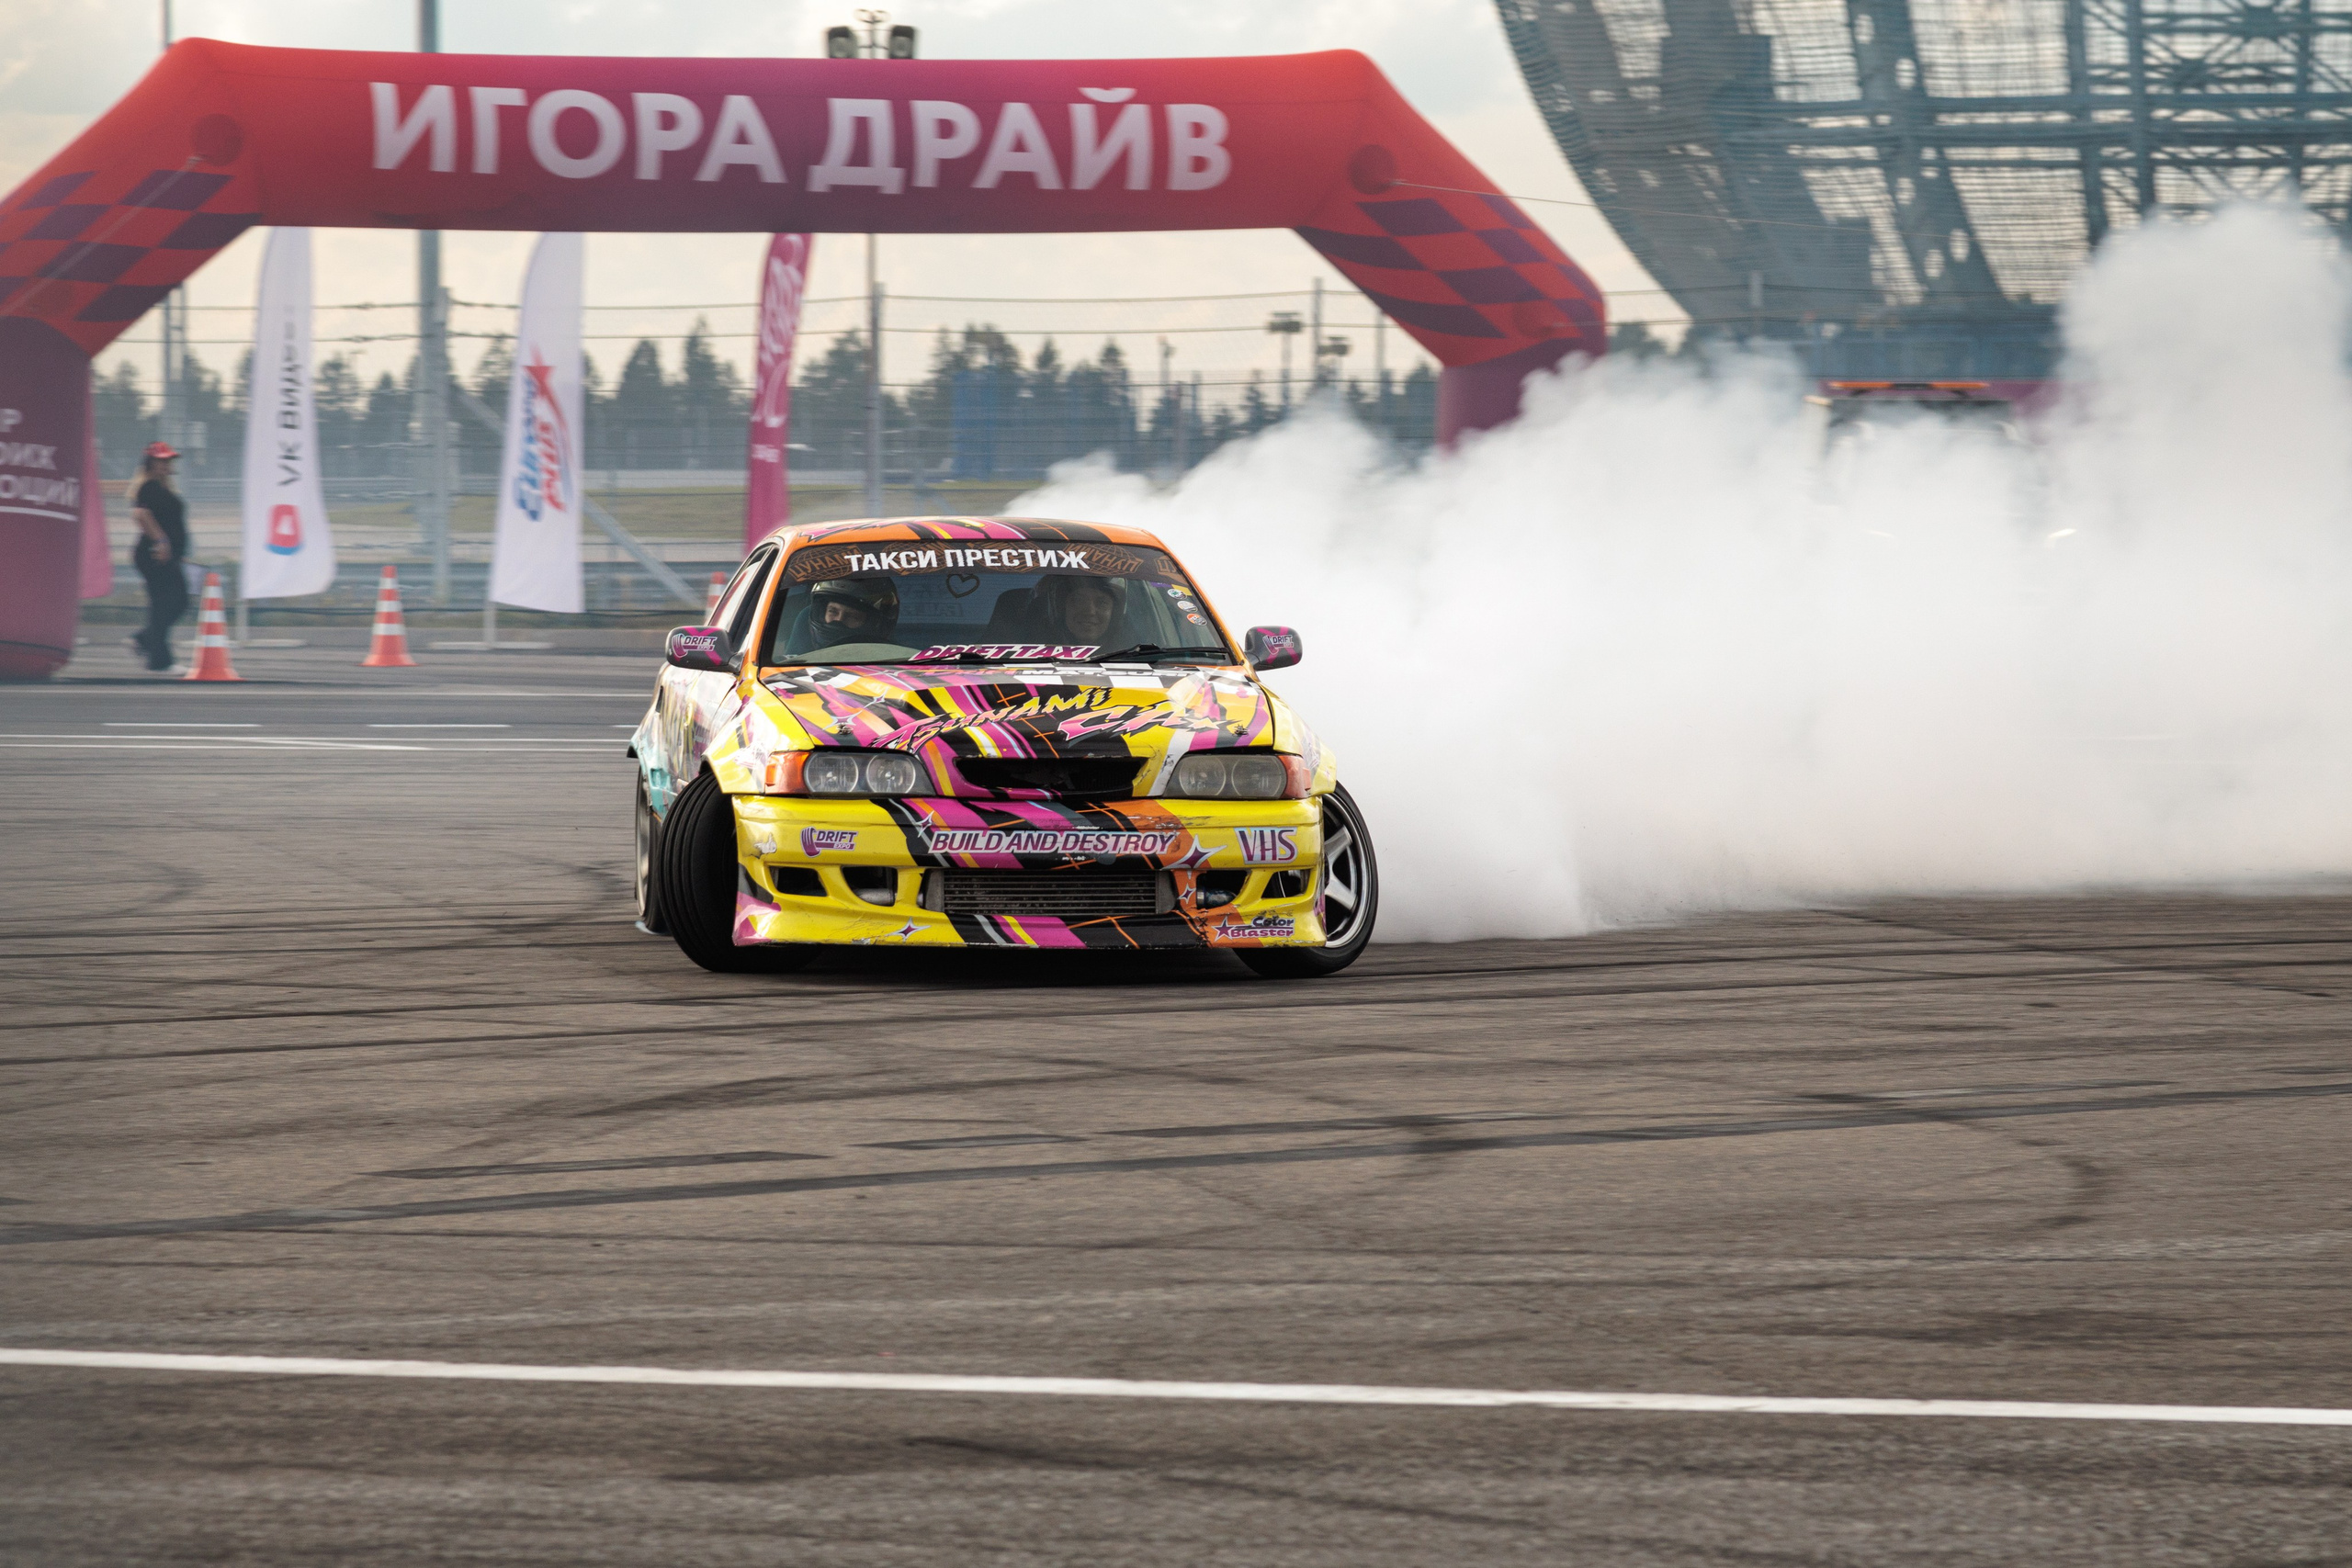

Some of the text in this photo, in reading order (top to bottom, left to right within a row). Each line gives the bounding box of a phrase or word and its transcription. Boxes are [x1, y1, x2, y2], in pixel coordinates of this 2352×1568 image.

[369, 81, 1233, 195] ИГОРА ДРАЙВ
[843, 550, 938, 572] ТАКСИ
[943, 548, 1091, 570] ПРЕСТИЖ
[684, 637, 717, 645] DRIFT
[1272, 636, 1294, 644] DRIFT
[816, 830, 857, 842] DRIFT
[930, 831, 1176, 853] BUILD AND DESTROY
[1237, 829, 1296, 862] VHS
[1230, 929, 1295, 938] Blaster
